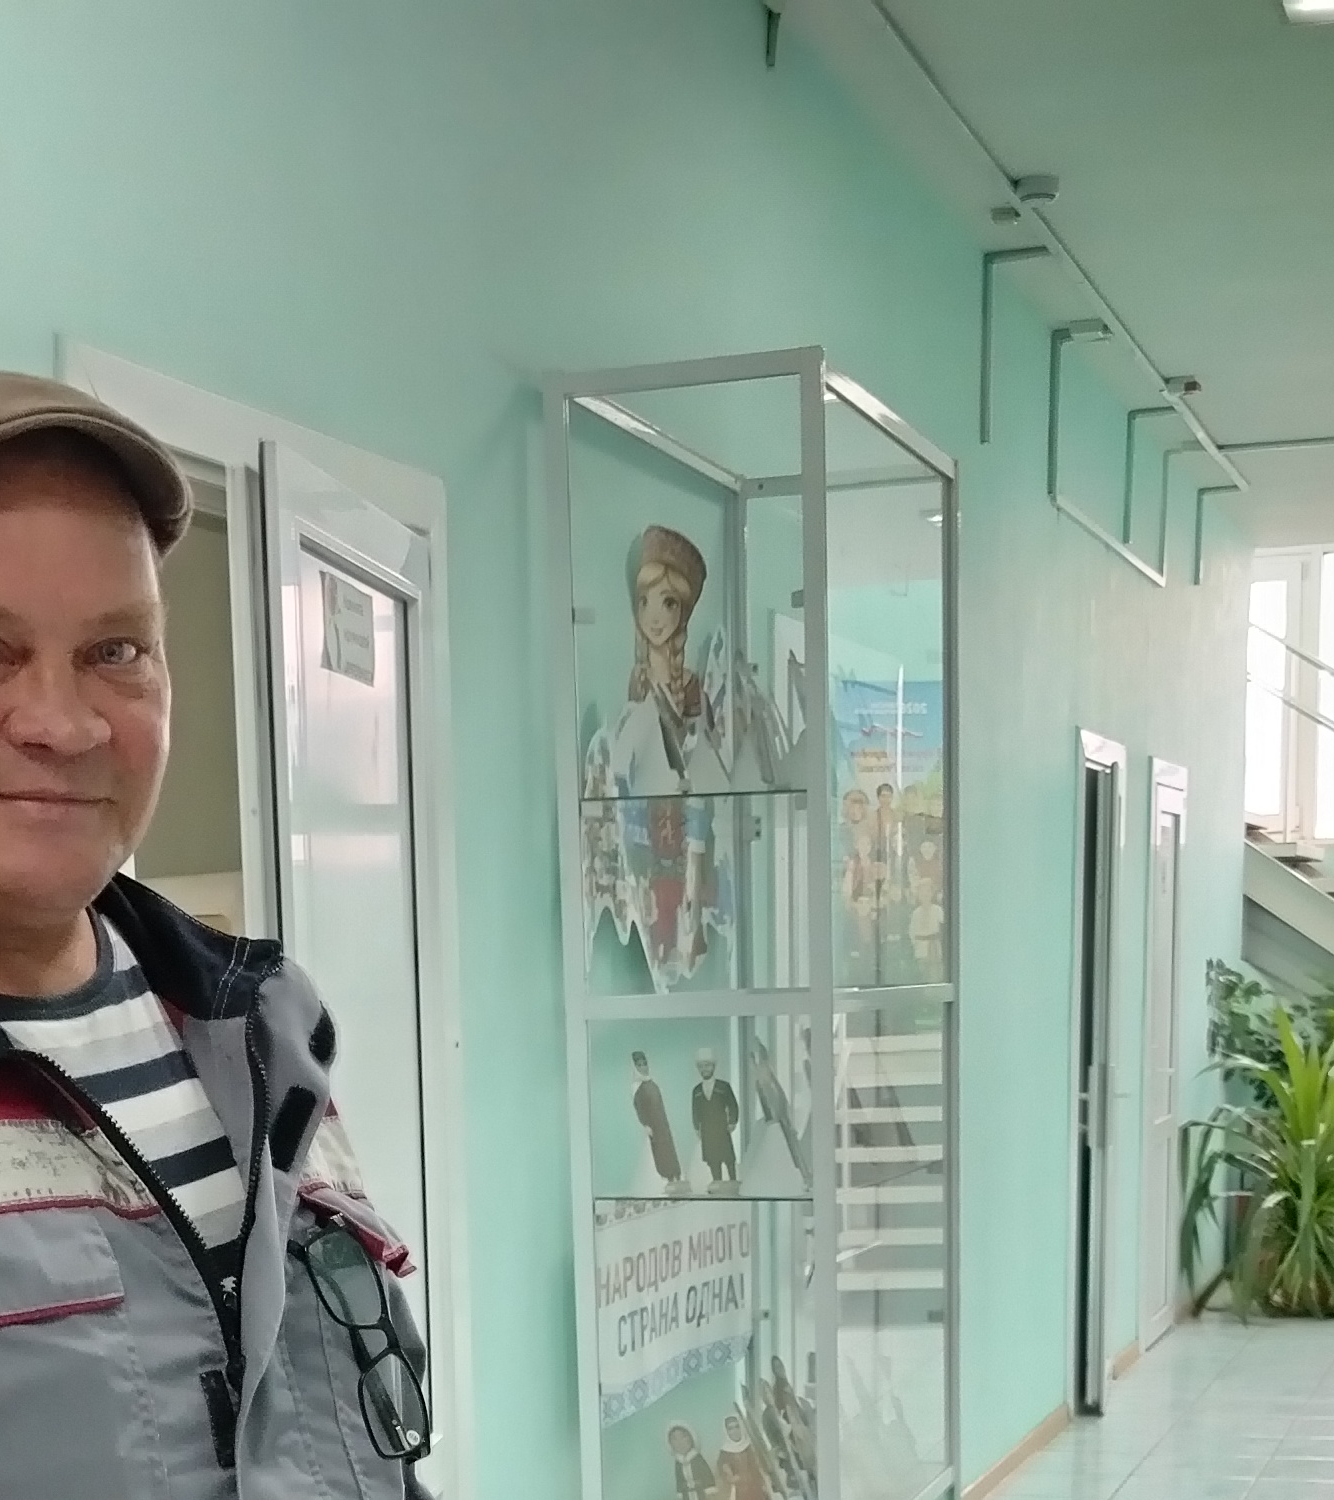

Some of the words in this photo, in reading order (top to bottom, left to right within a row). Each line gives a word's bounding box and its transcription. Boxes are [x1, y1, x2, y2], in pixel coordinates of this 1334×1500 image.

[597, 1239, 683, 1309] НАРОДОВ
[688, 1220, 750, 1273] МНОГО
[618, 1291, 680, 1358] СТРАНА
[685, 1272, 746, 1329] ОДНА!
